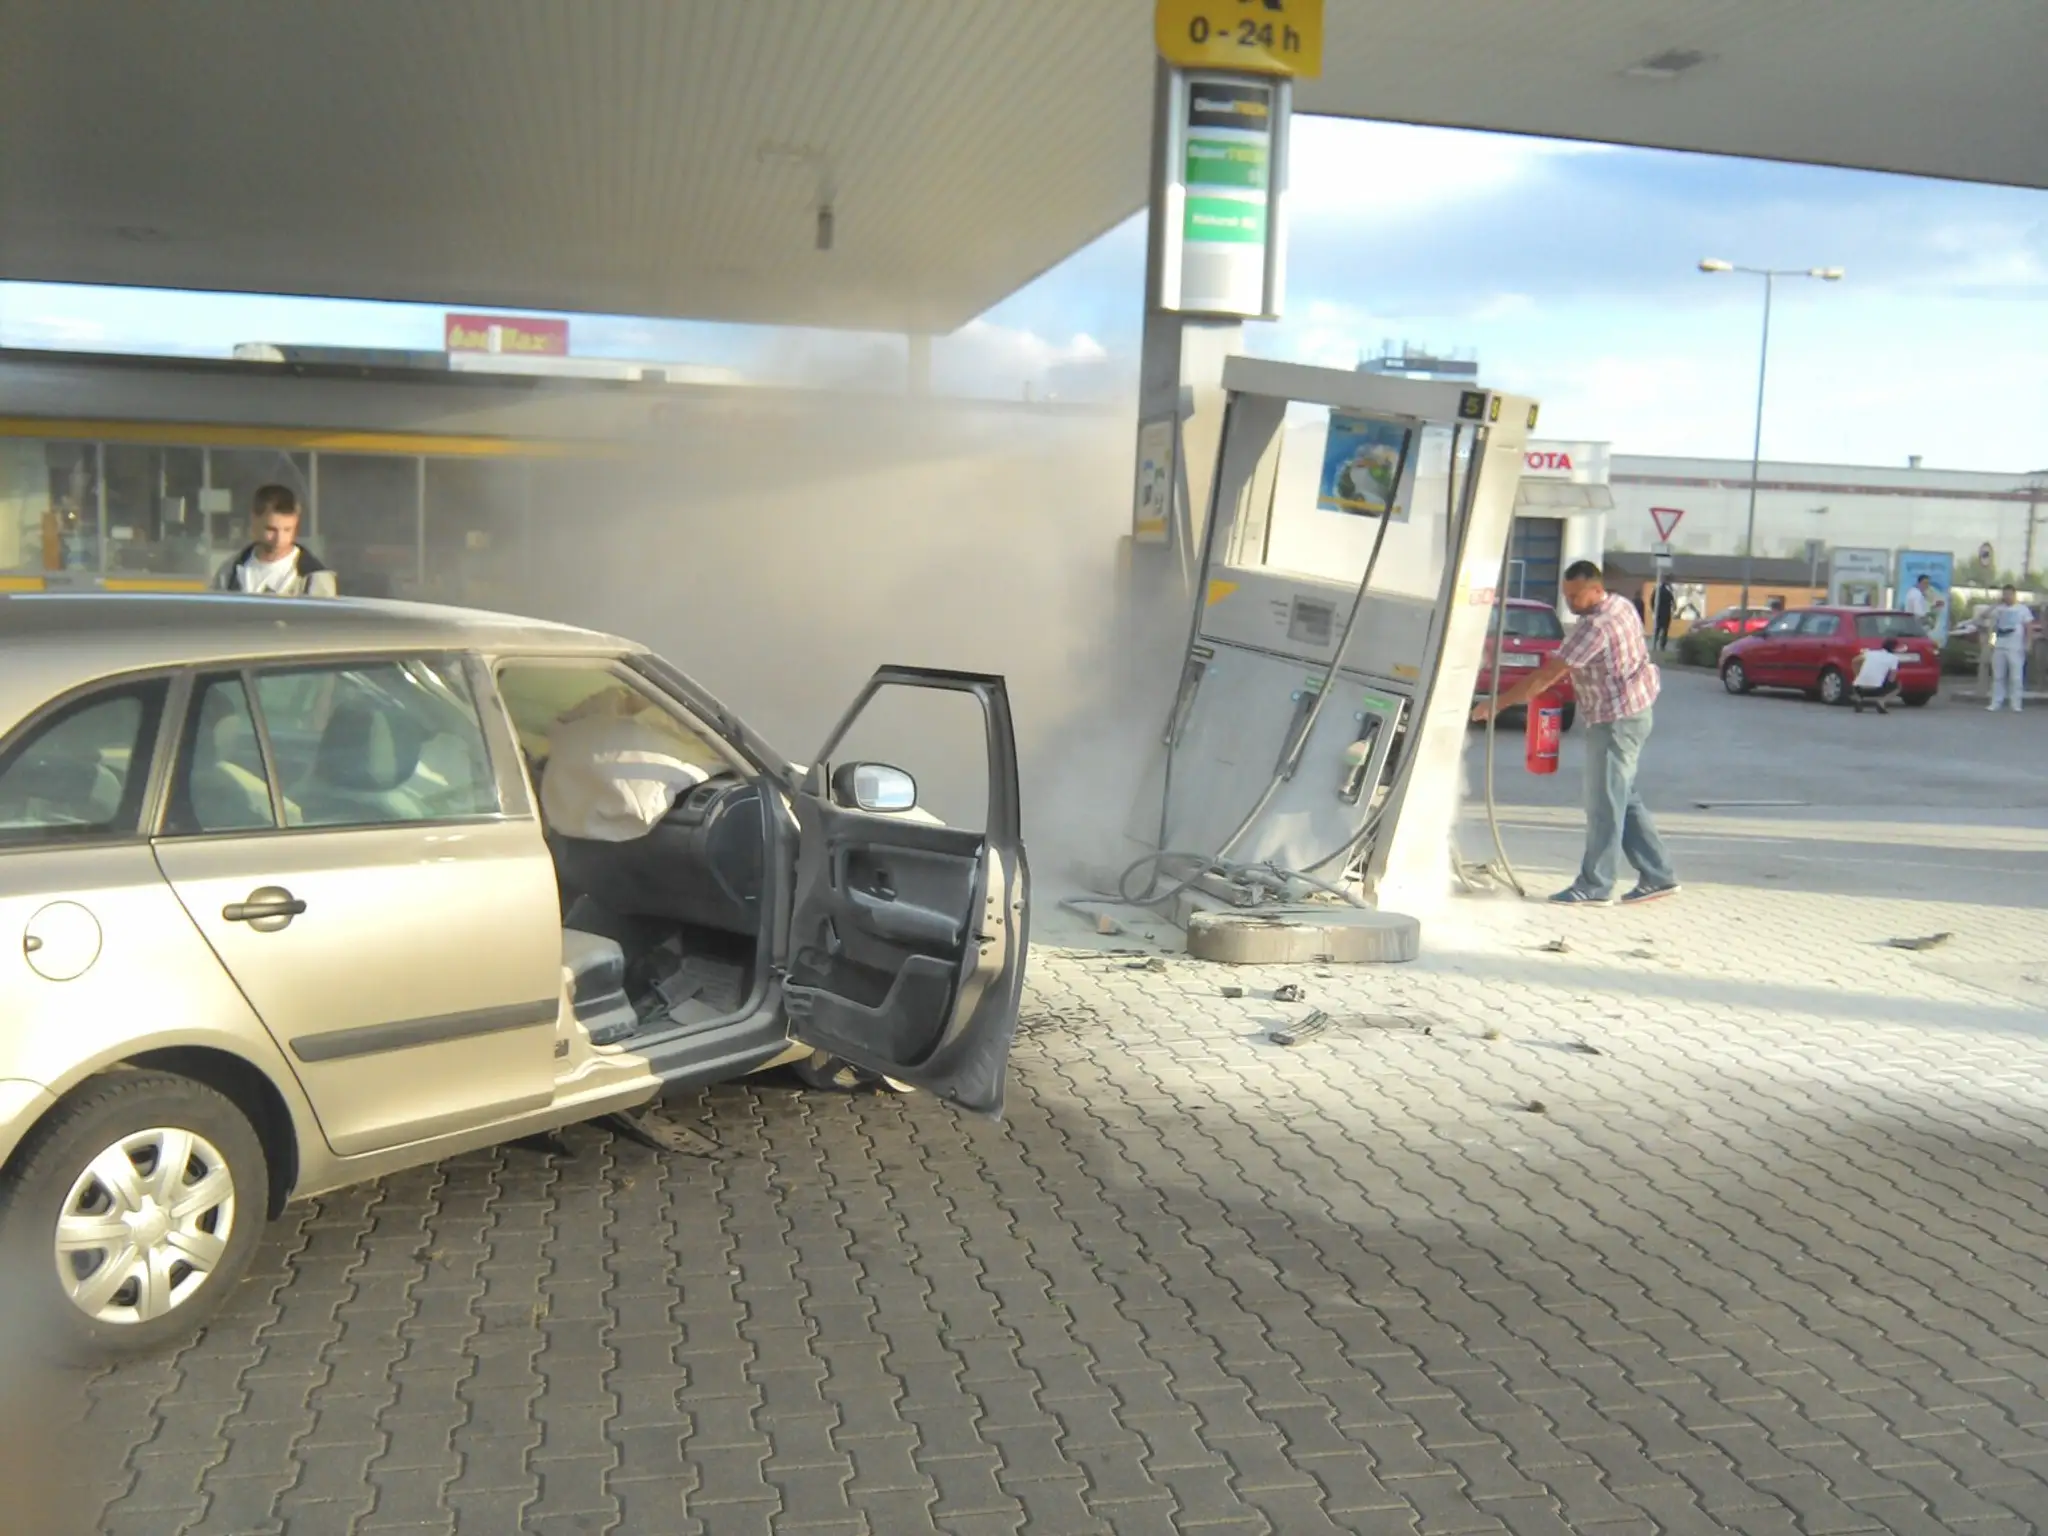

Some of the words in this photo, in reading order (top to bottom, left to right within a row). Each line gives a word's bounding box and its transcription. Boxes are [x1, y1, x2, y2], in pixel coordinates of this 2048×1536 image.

[1189, 15, 1209, 43] 0
[1238, 19, 1274, 48] 24
[1283, 24, 1300, 53] h
